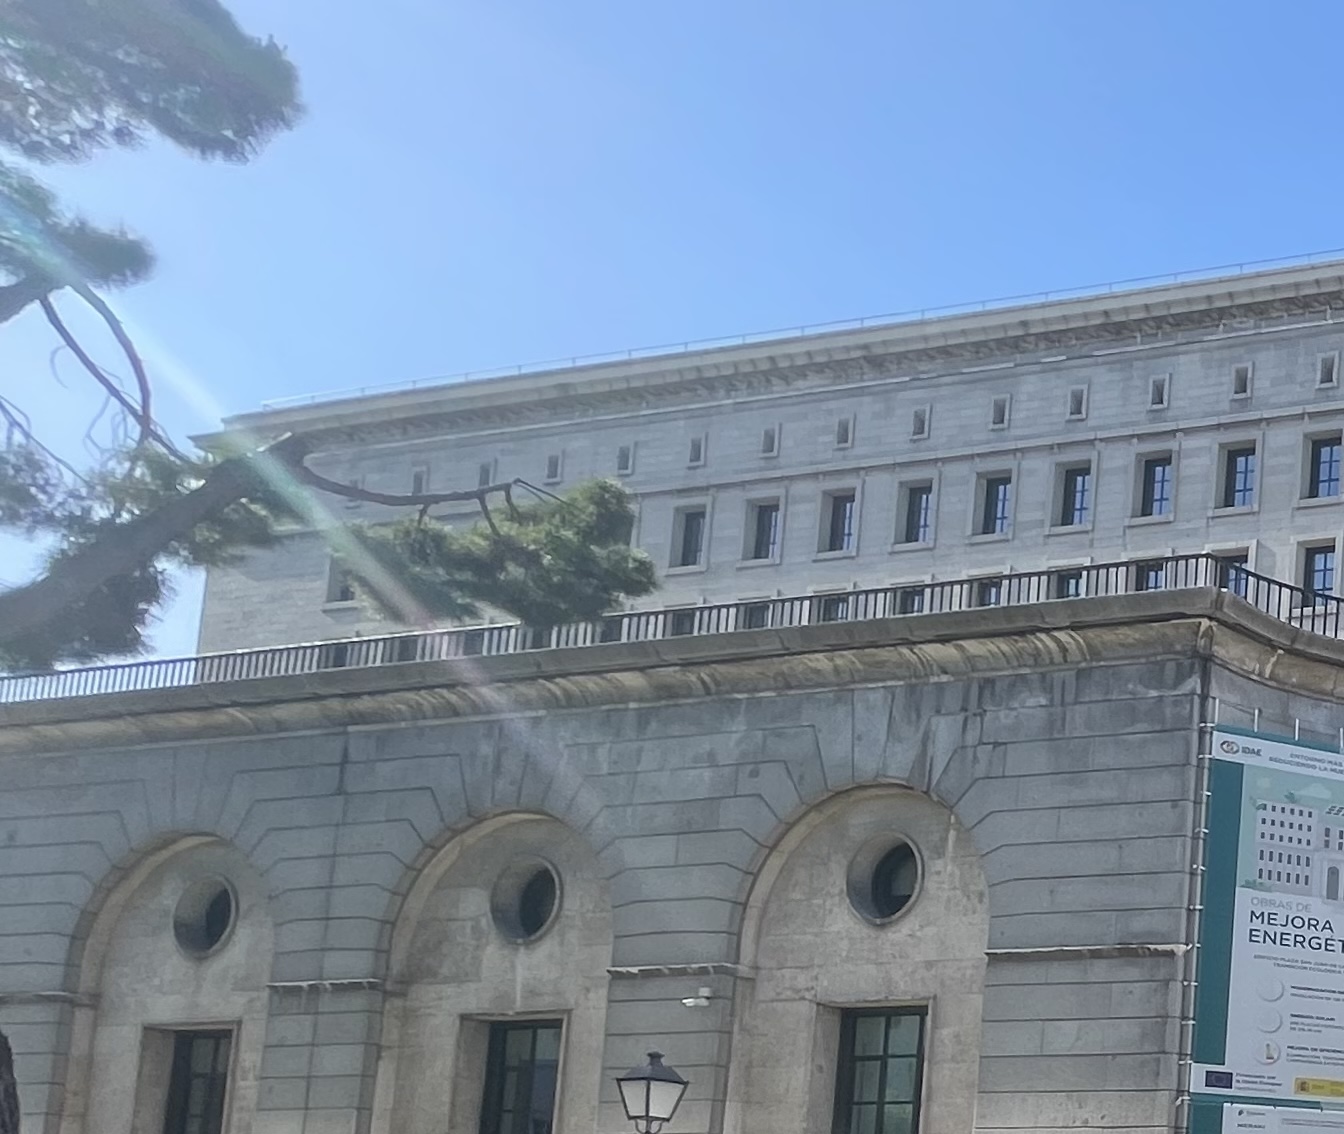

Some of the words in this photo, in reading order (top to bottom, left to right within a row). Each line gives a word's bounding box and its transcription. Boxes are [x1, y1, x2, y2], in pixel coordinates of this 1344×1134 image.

[1250, 897, 1293, 911] OBRAS
[1296, 902, 1312, 913] DE
[1250, 910, 1335, 933] MEJORA
